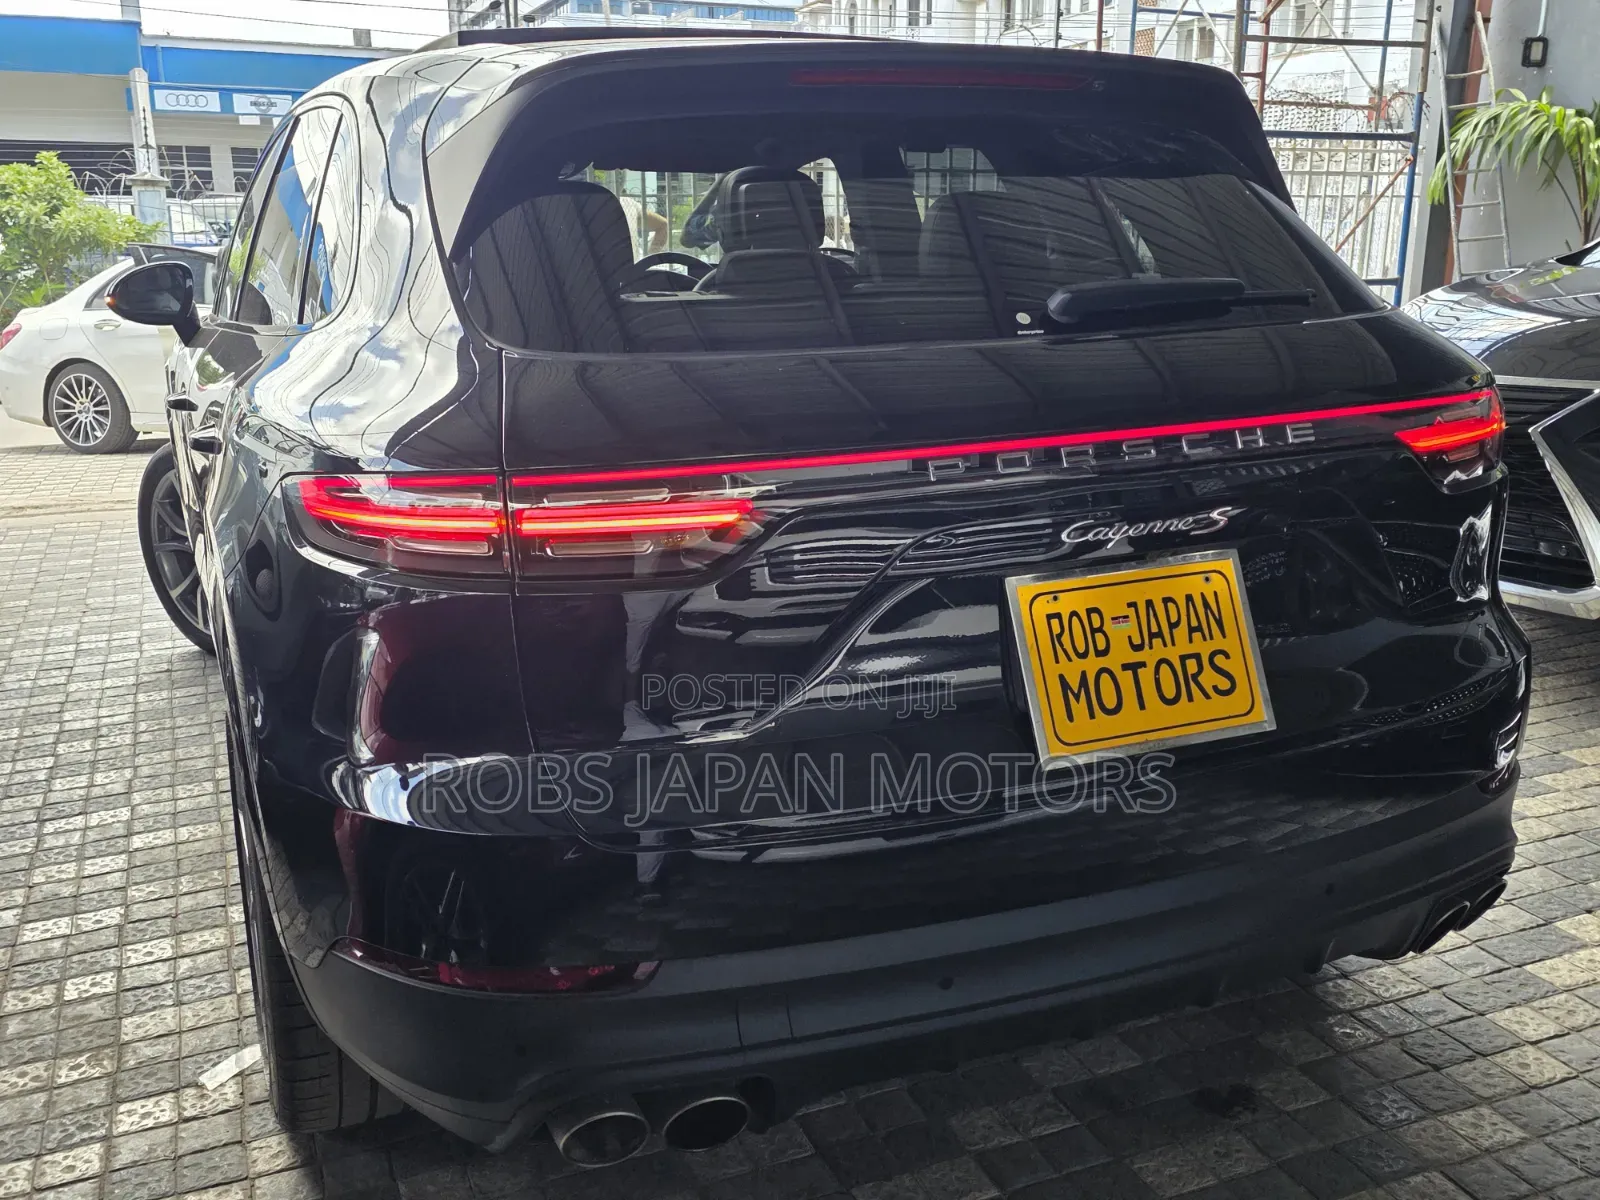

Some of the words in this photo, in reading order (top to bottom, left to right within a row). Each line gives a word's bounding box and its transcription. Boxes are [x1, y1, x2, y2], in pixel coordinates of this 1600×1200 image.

[928, 422, 1316, 481] PORSCHE
[1061, 515, 1195, 549] Cayenne
[1045, 606, 1111, 664] ROB
[1126, 591, 1226, 653] JAPAN
[1058, 648, 1237, 723] MOTORS
